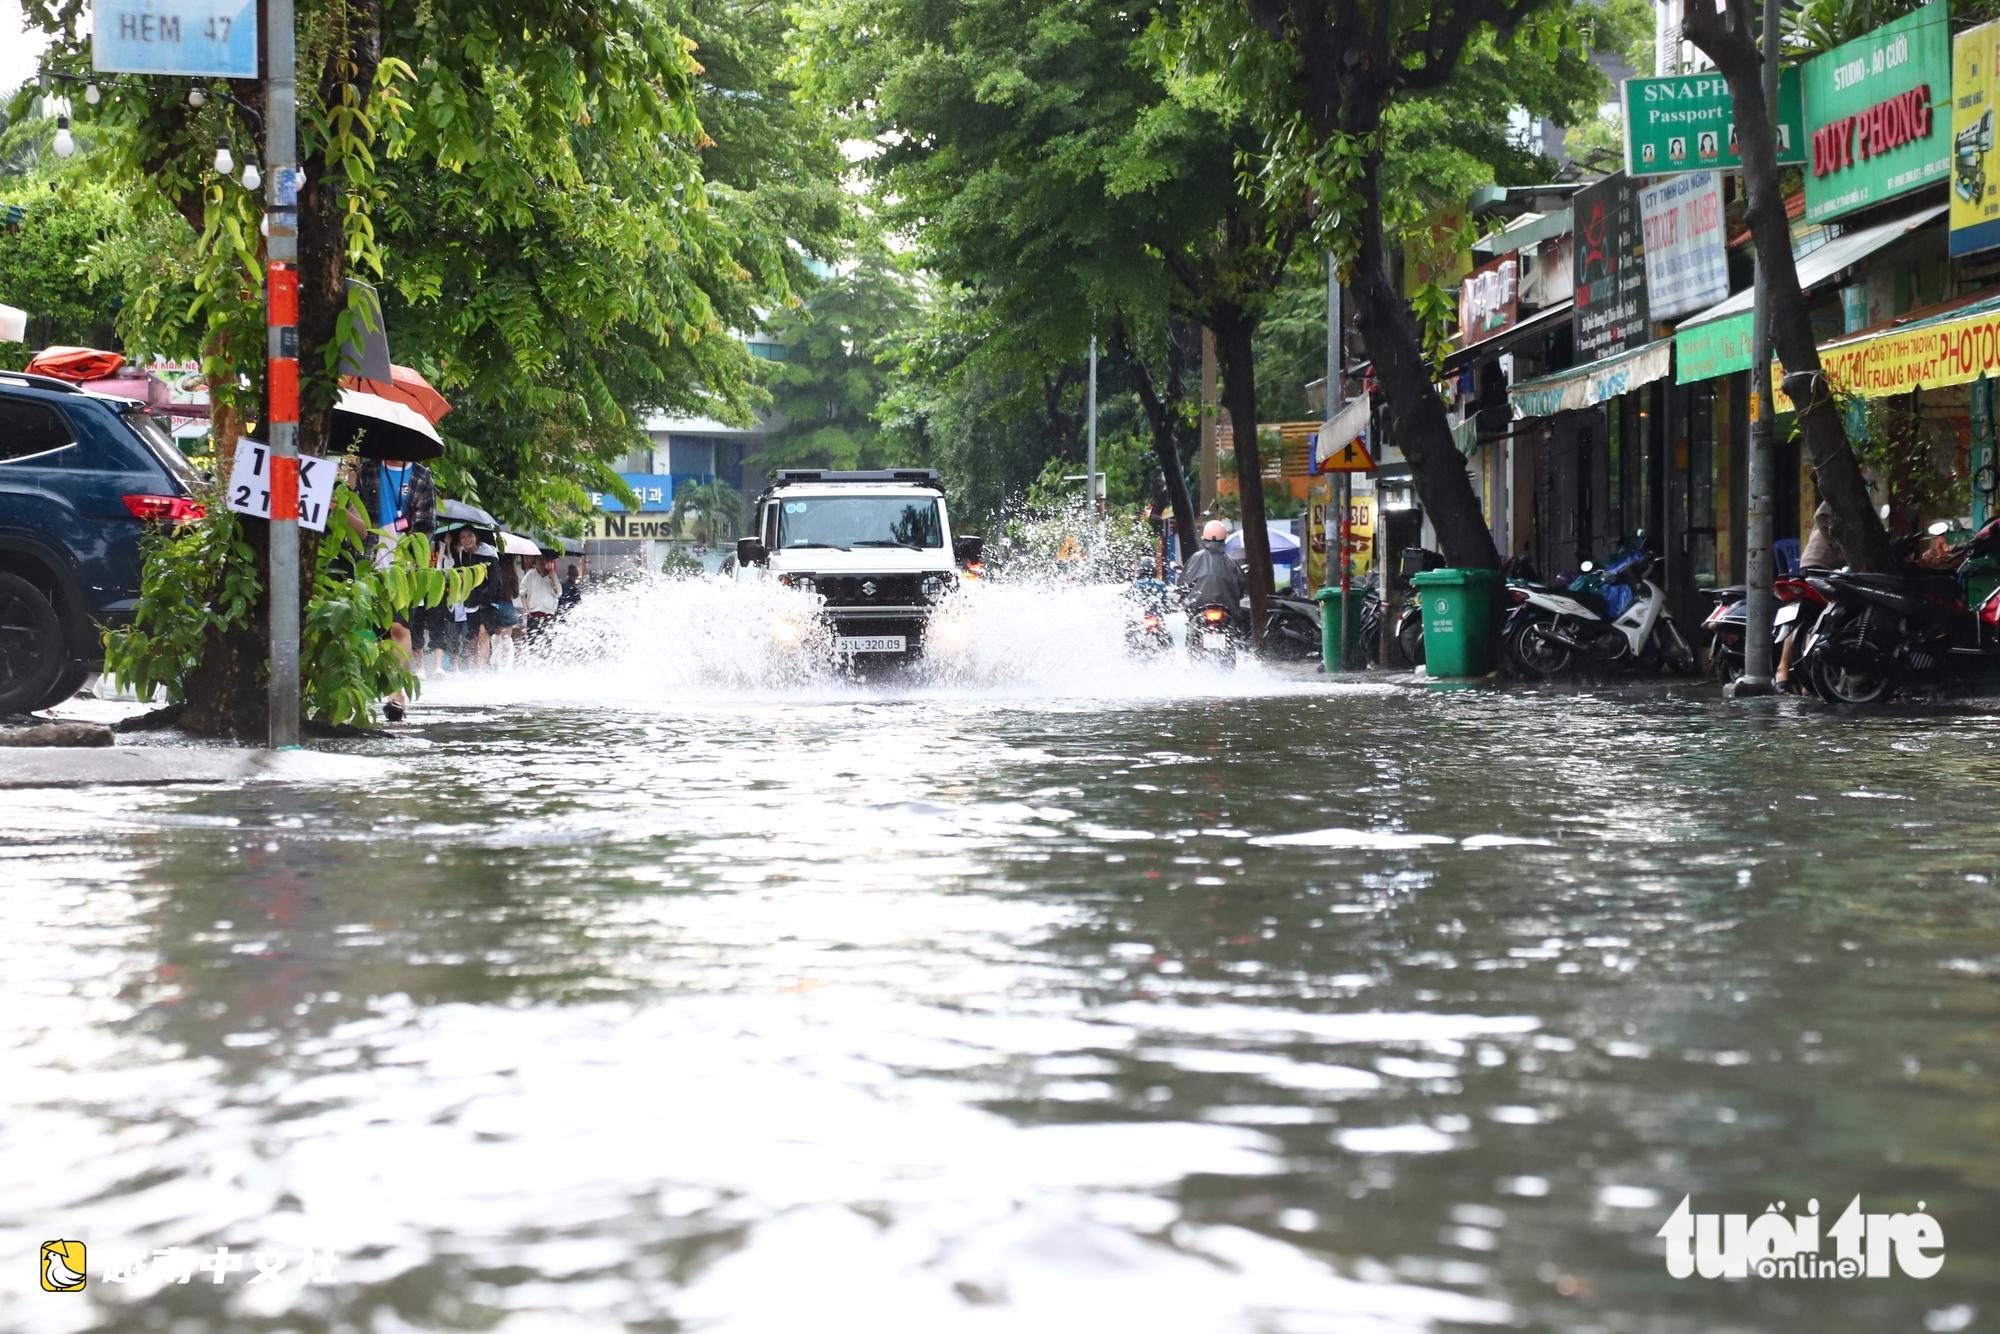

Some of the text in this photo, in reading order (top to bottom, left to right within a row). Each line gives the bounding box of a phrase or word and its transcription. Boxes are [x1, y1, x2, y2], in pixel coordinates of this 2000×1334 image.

[204, 15, 232, 43] 47
[1834, 57, 1865, 92] STUDIO
[1649, 105, 1724, 124] Passport
[1811, 116, 1855, 178] DUY
[1856, 84, 1933, 161] PHONG
[234, 485, 252, 508] 2
